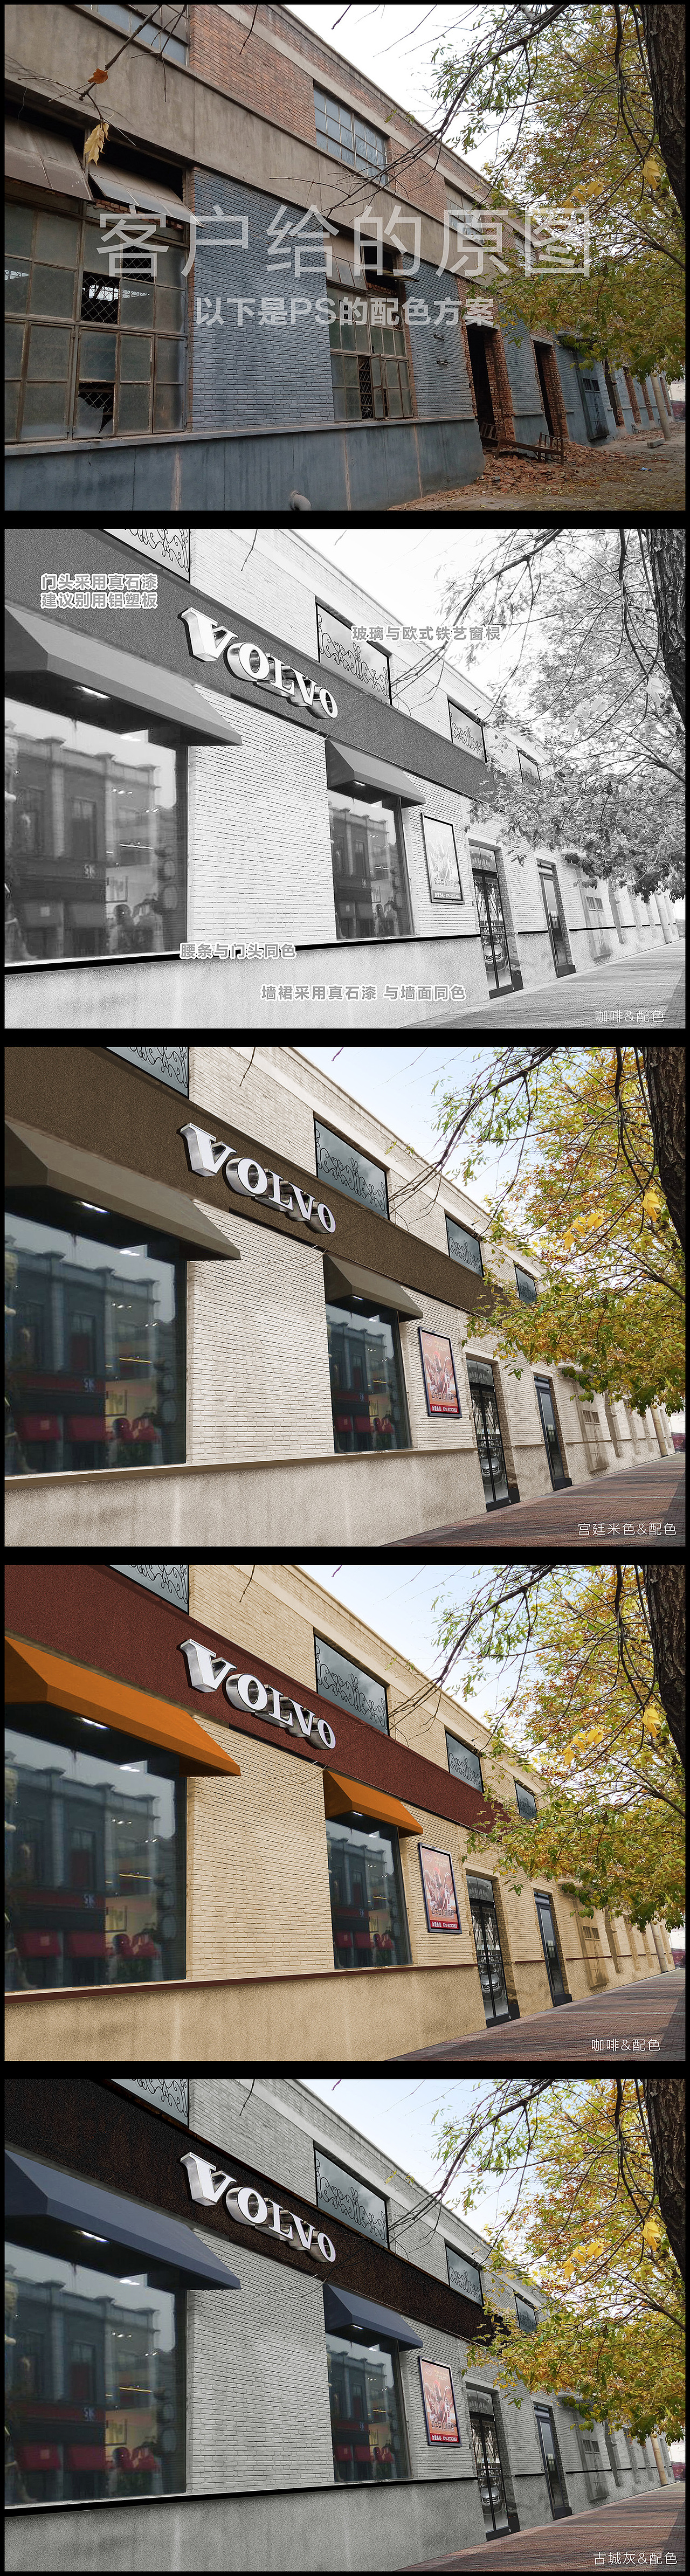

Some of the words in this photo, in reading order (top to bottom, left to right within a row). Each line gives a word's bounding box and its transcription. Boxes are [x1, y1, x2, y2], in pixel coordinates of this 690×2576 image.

[179, 607, 338, 719] VOLVO
[179, 1123, 336, 1234] VOLVO
[179, 1639, 336, 1750] VOLVO
[179, 2152, 336, 2262] VOLVO
